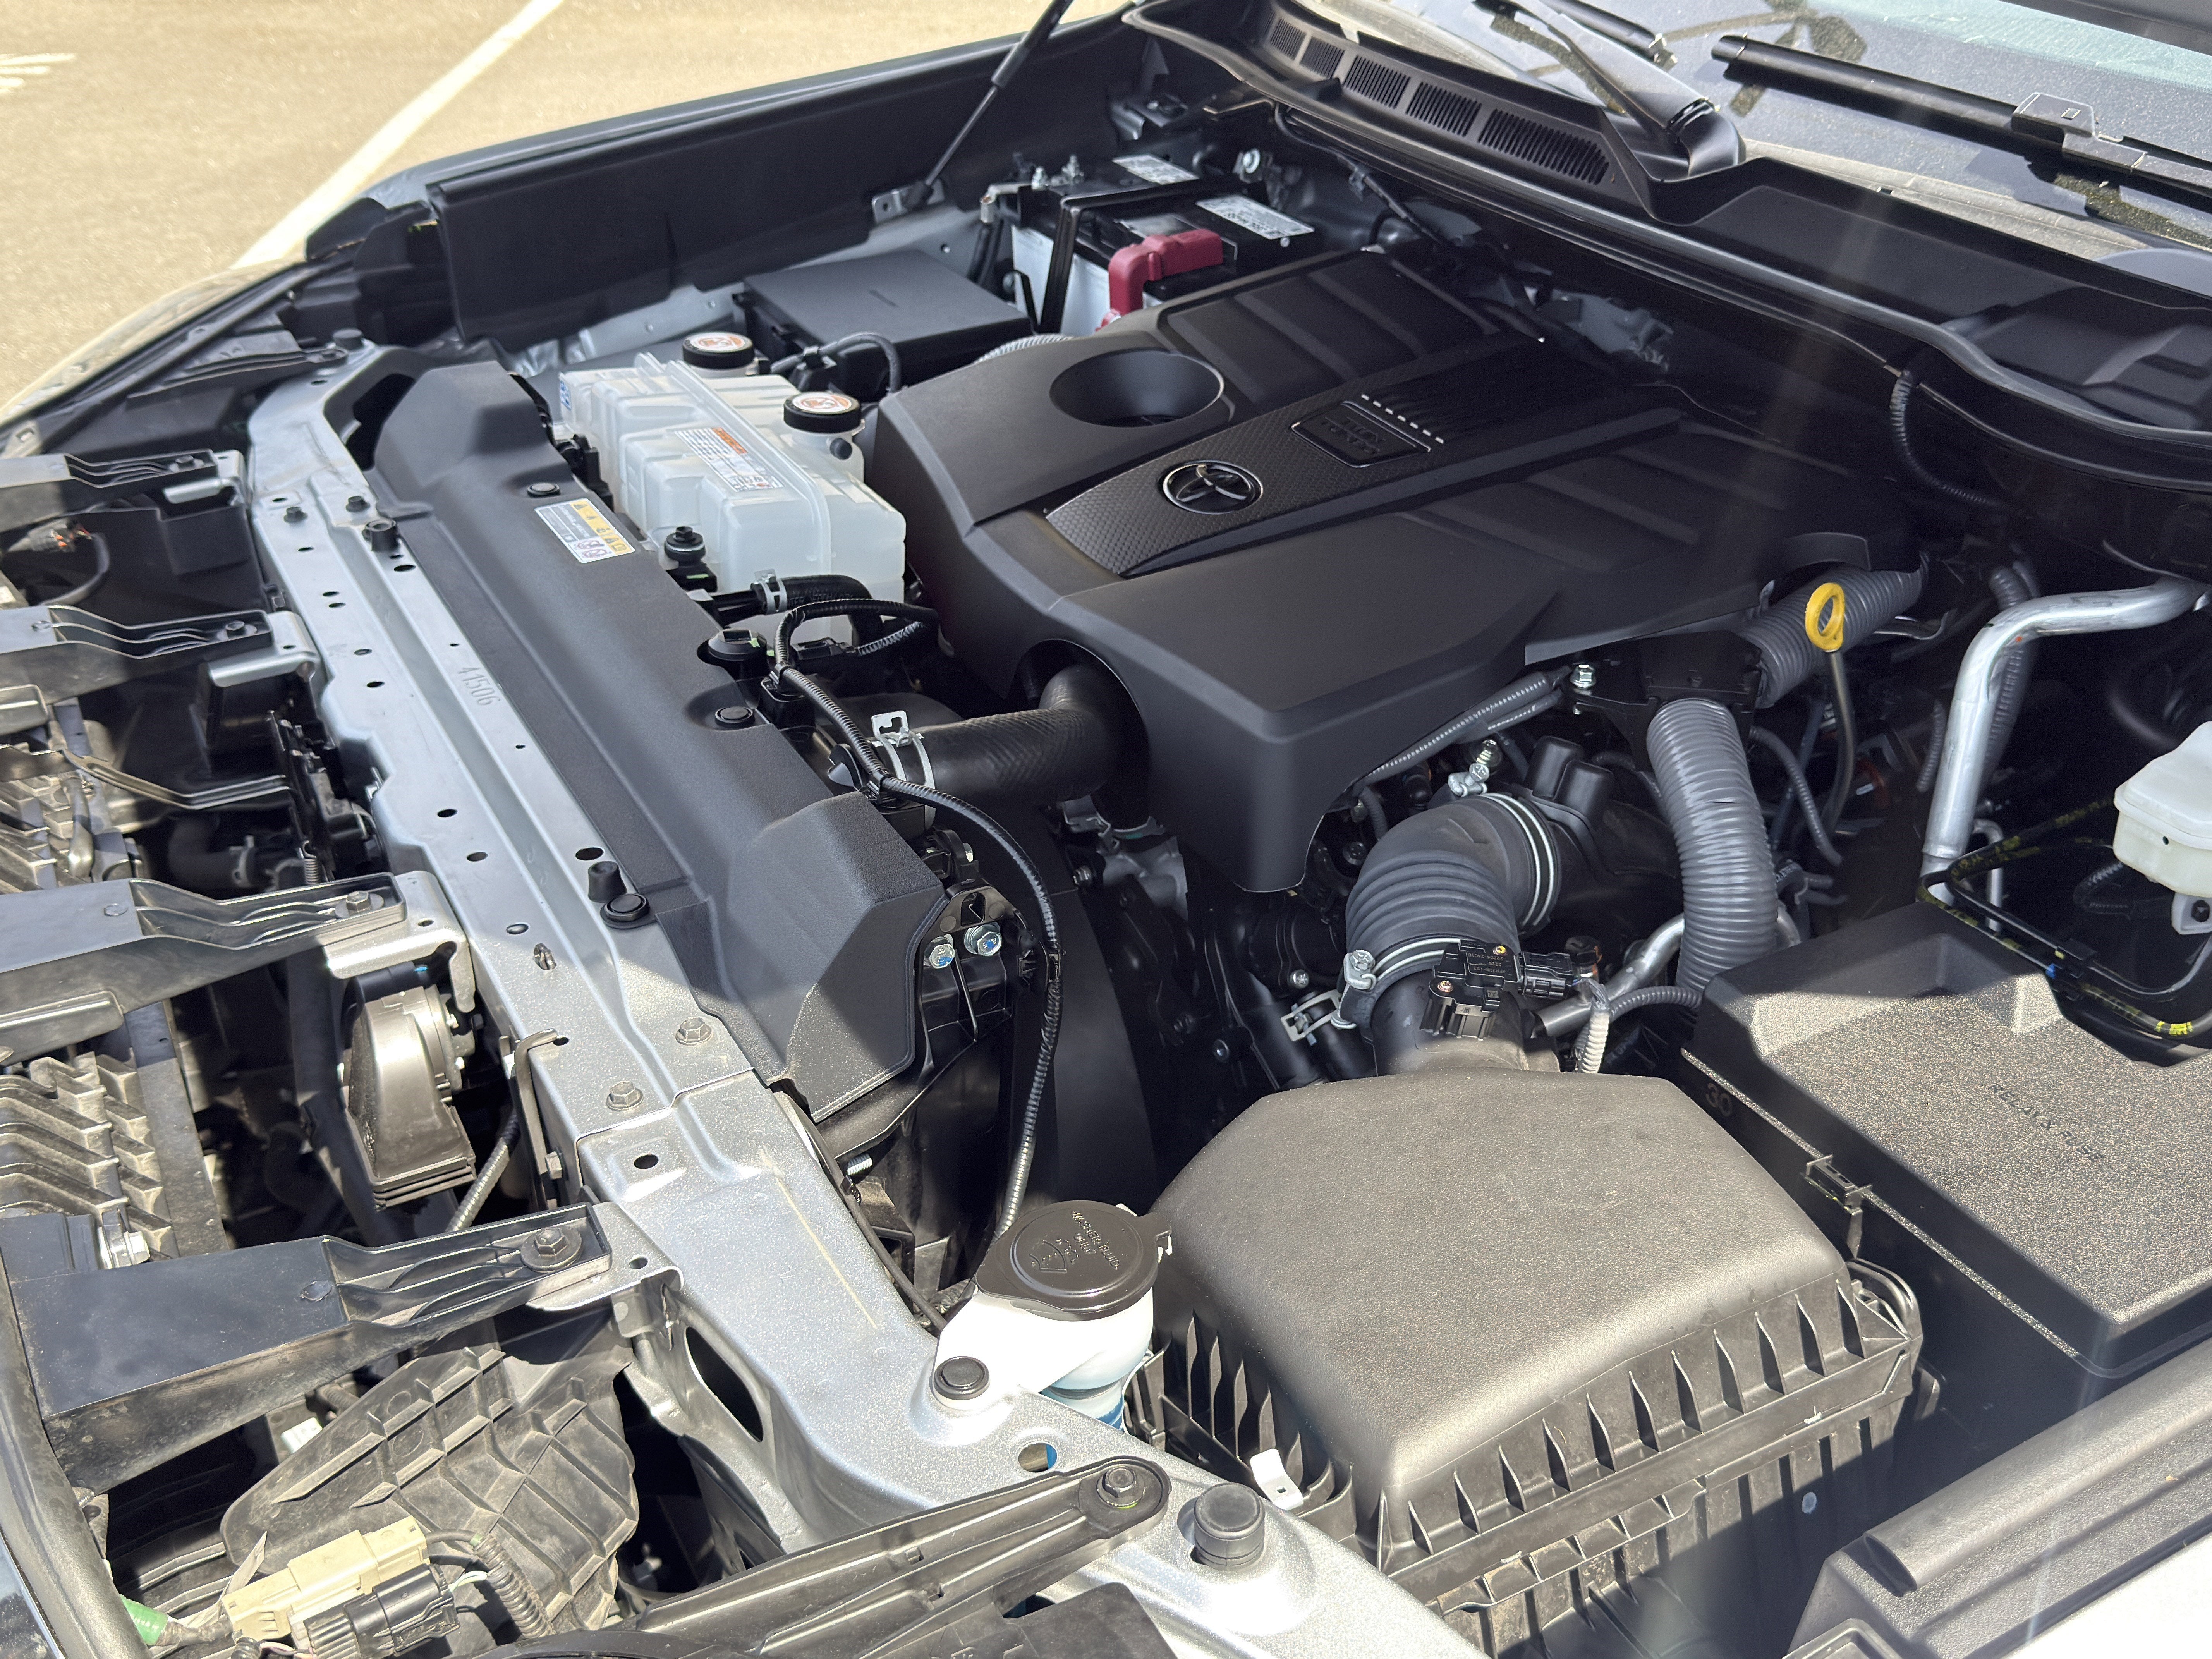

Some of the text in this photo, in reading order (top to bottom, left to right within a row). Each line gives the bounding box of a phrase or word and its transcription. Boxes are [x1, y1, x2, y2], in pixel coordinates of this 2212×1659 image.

[1987, 1084, 2047, 1120] RELAY
[2054, 1130, 2106, 1162] FUSE
[1072, 1211, 1120, 1270] WASHER FLUID
[1074, 1233, 1096, 1254] ONLY
